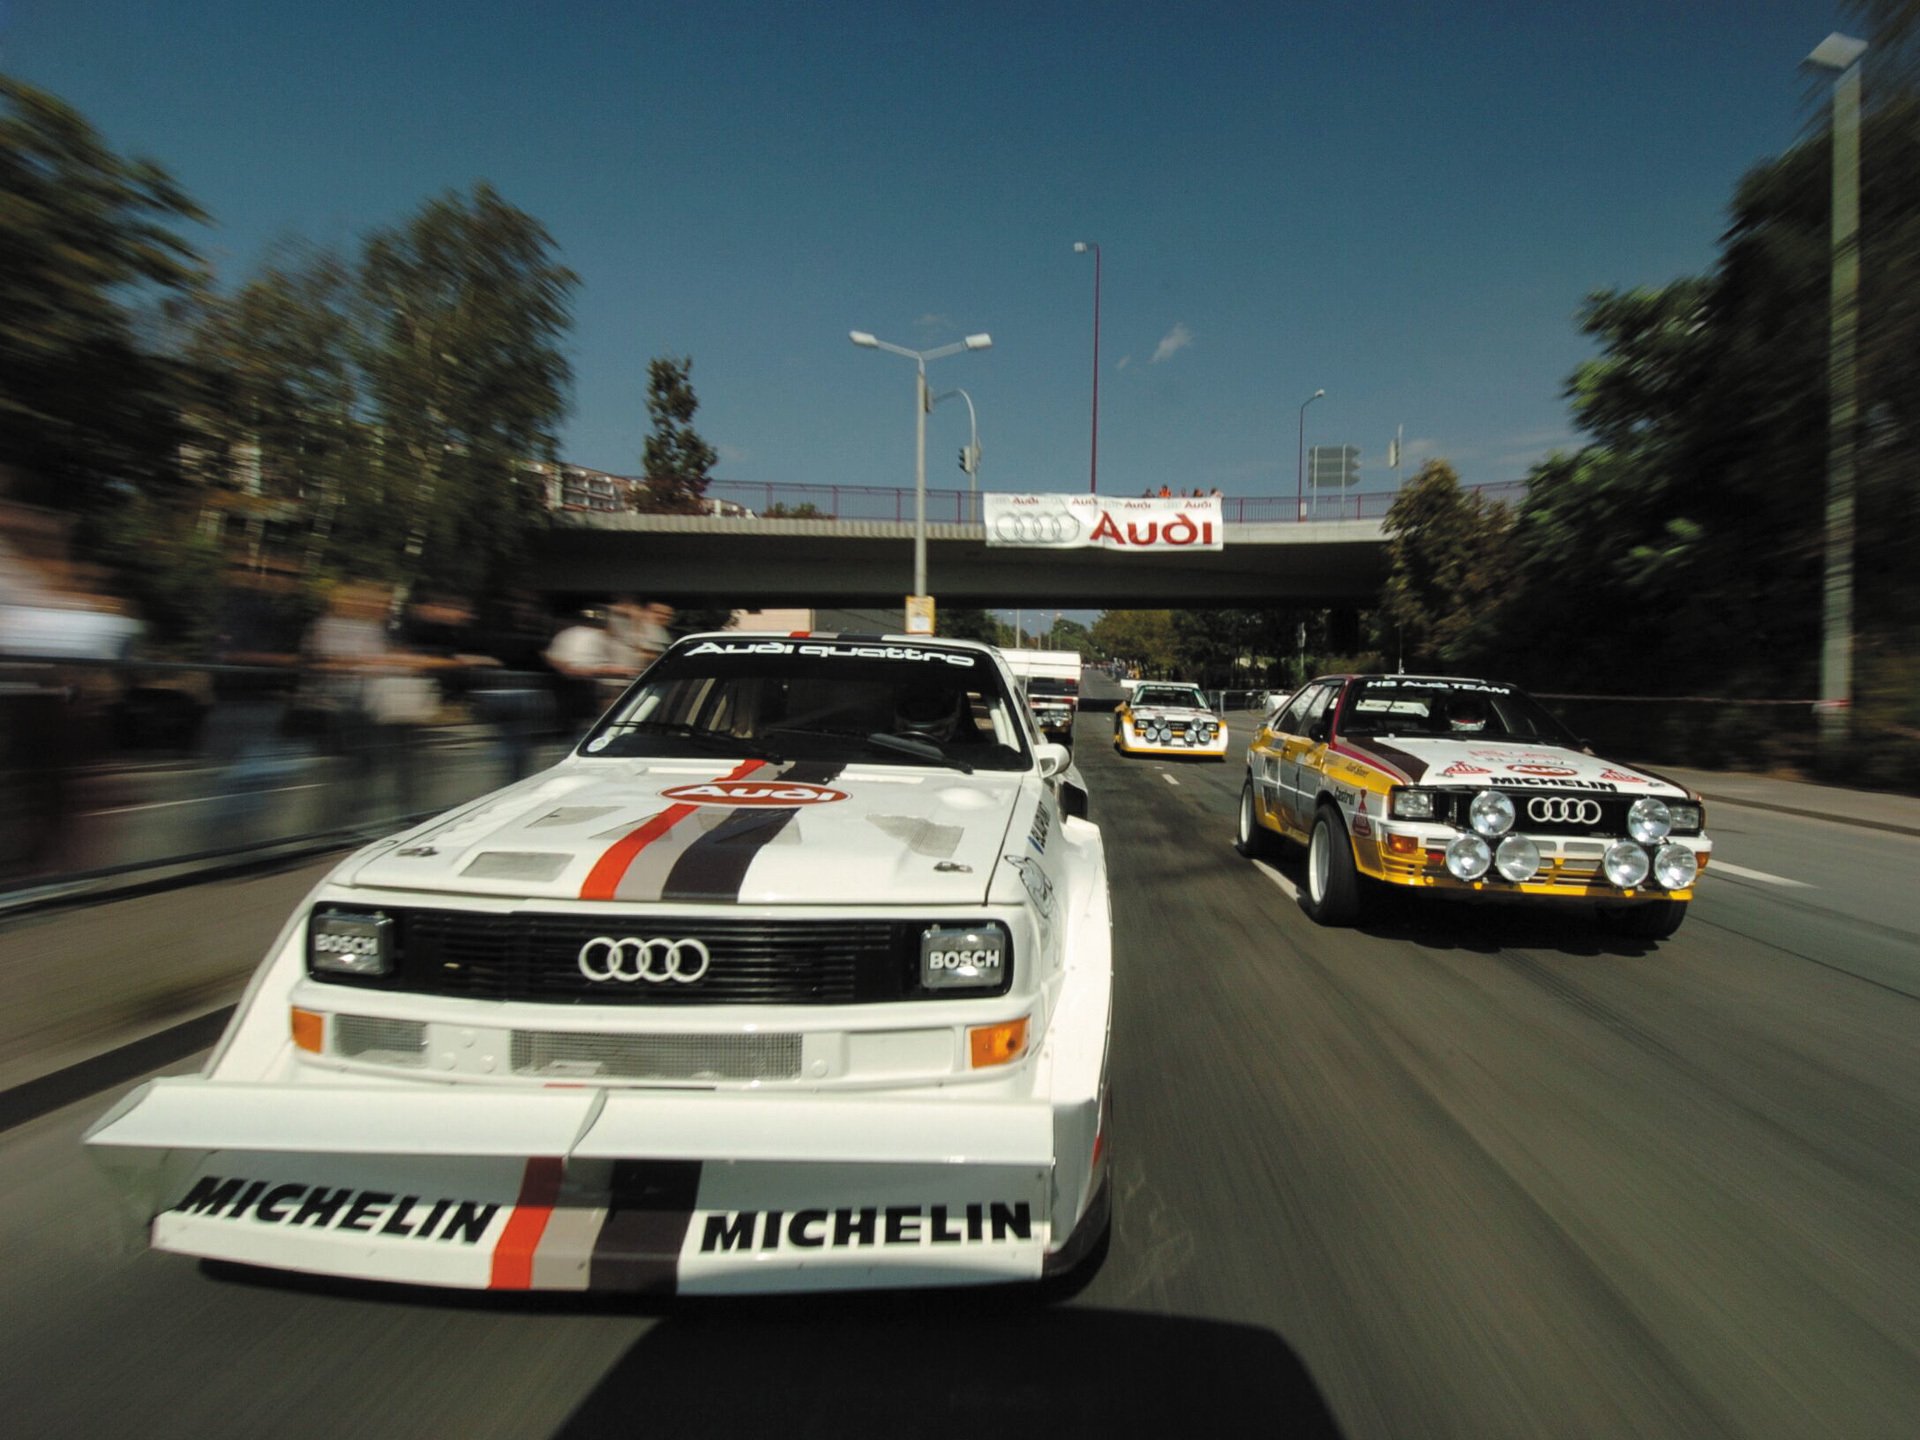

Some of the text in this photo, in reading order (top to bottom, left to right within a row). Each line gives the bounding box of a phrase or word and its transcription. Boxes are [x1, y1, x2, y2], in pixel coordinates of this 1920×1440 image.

[1090, 511, 1212, 545] Audi
[684, 642, 974, 666] Audi quattro
[1451, 683, 1510, 694] TEAM
[669, 785, 837, 801] Audi
[1489, 777, 1617, 791] MICHELIN
[1335, 786, 1355, 805] Castrol
[315, 933, 378, 955] BOSCH
[930, 950, 1000, 969] BOSCH
[176, 1175, 499, 1244] MICHELIN
[700, 1201, 1032, 1252] MICHELIN
